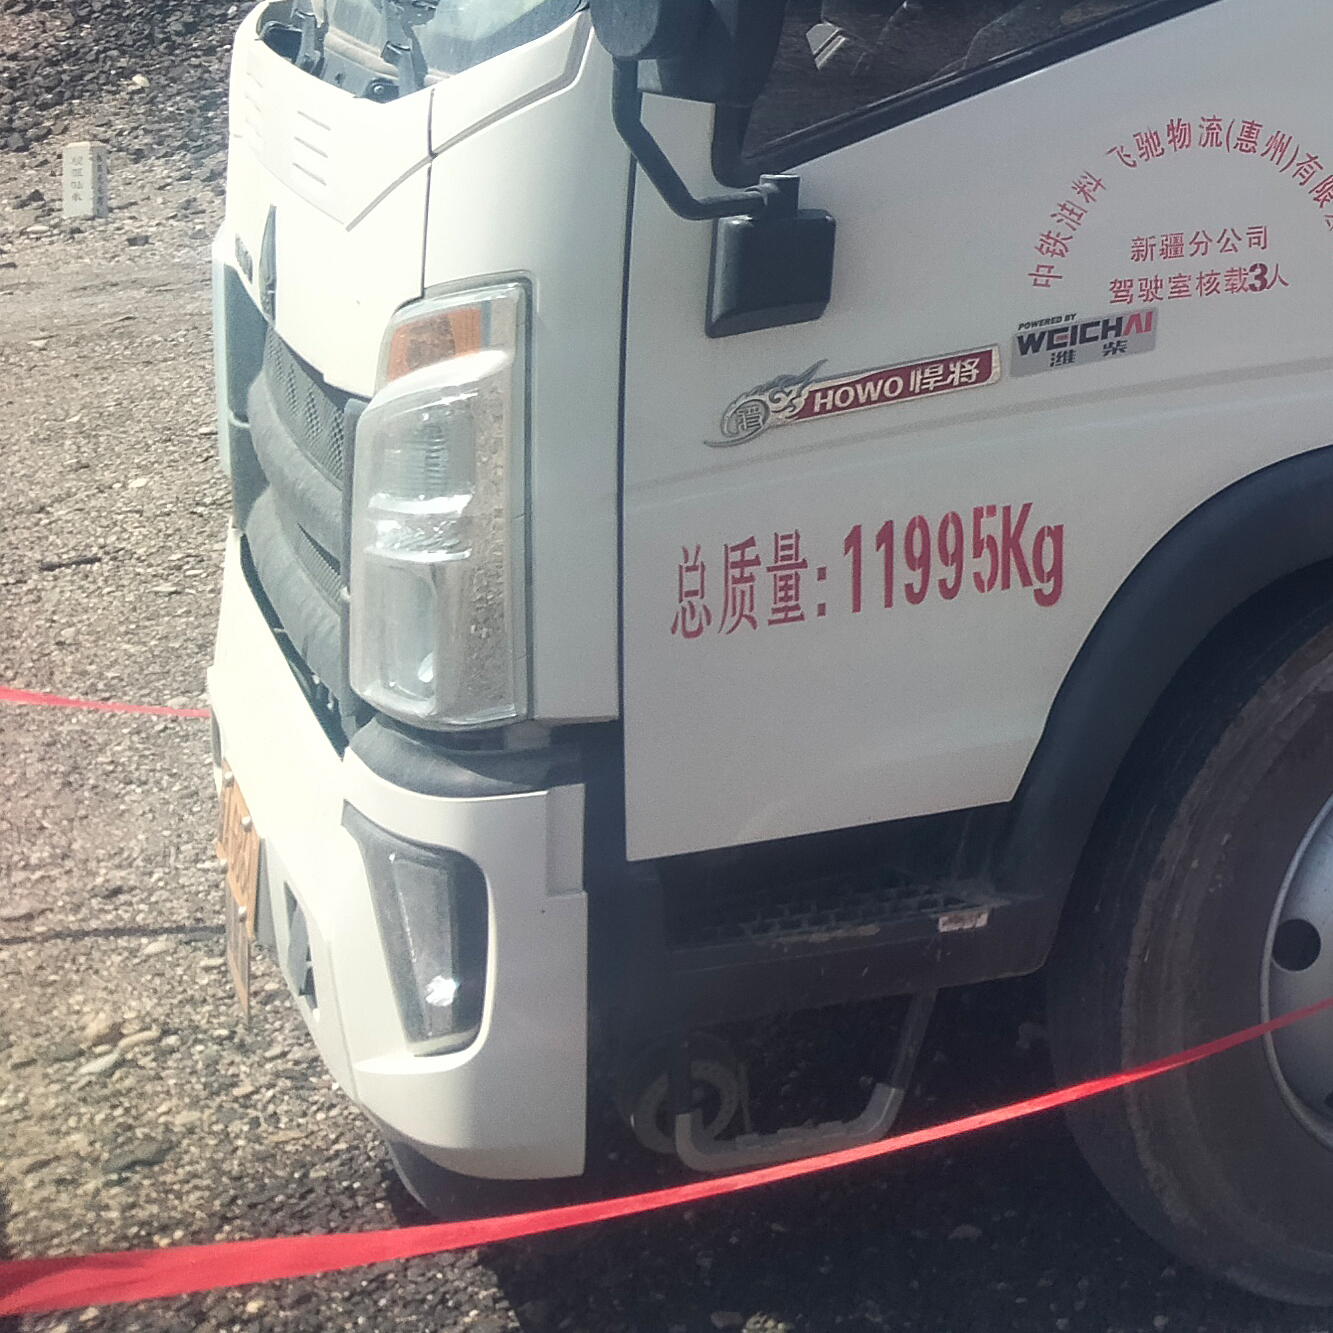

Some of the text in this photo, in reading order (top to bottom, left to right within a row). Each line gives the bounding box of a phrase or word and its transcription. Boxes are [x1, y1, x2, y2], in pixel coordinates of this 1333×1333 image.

[1130, 225, 1268, 263] 新疆分公司
[1108, 263, 1289, 306] 驾驶室核载3人
[1017, 311, 1153, 356] WEICHAI
[1018, 313, 1077, 331] POWERED BY
[813, 356, 981, 413] HOWO 悍将
